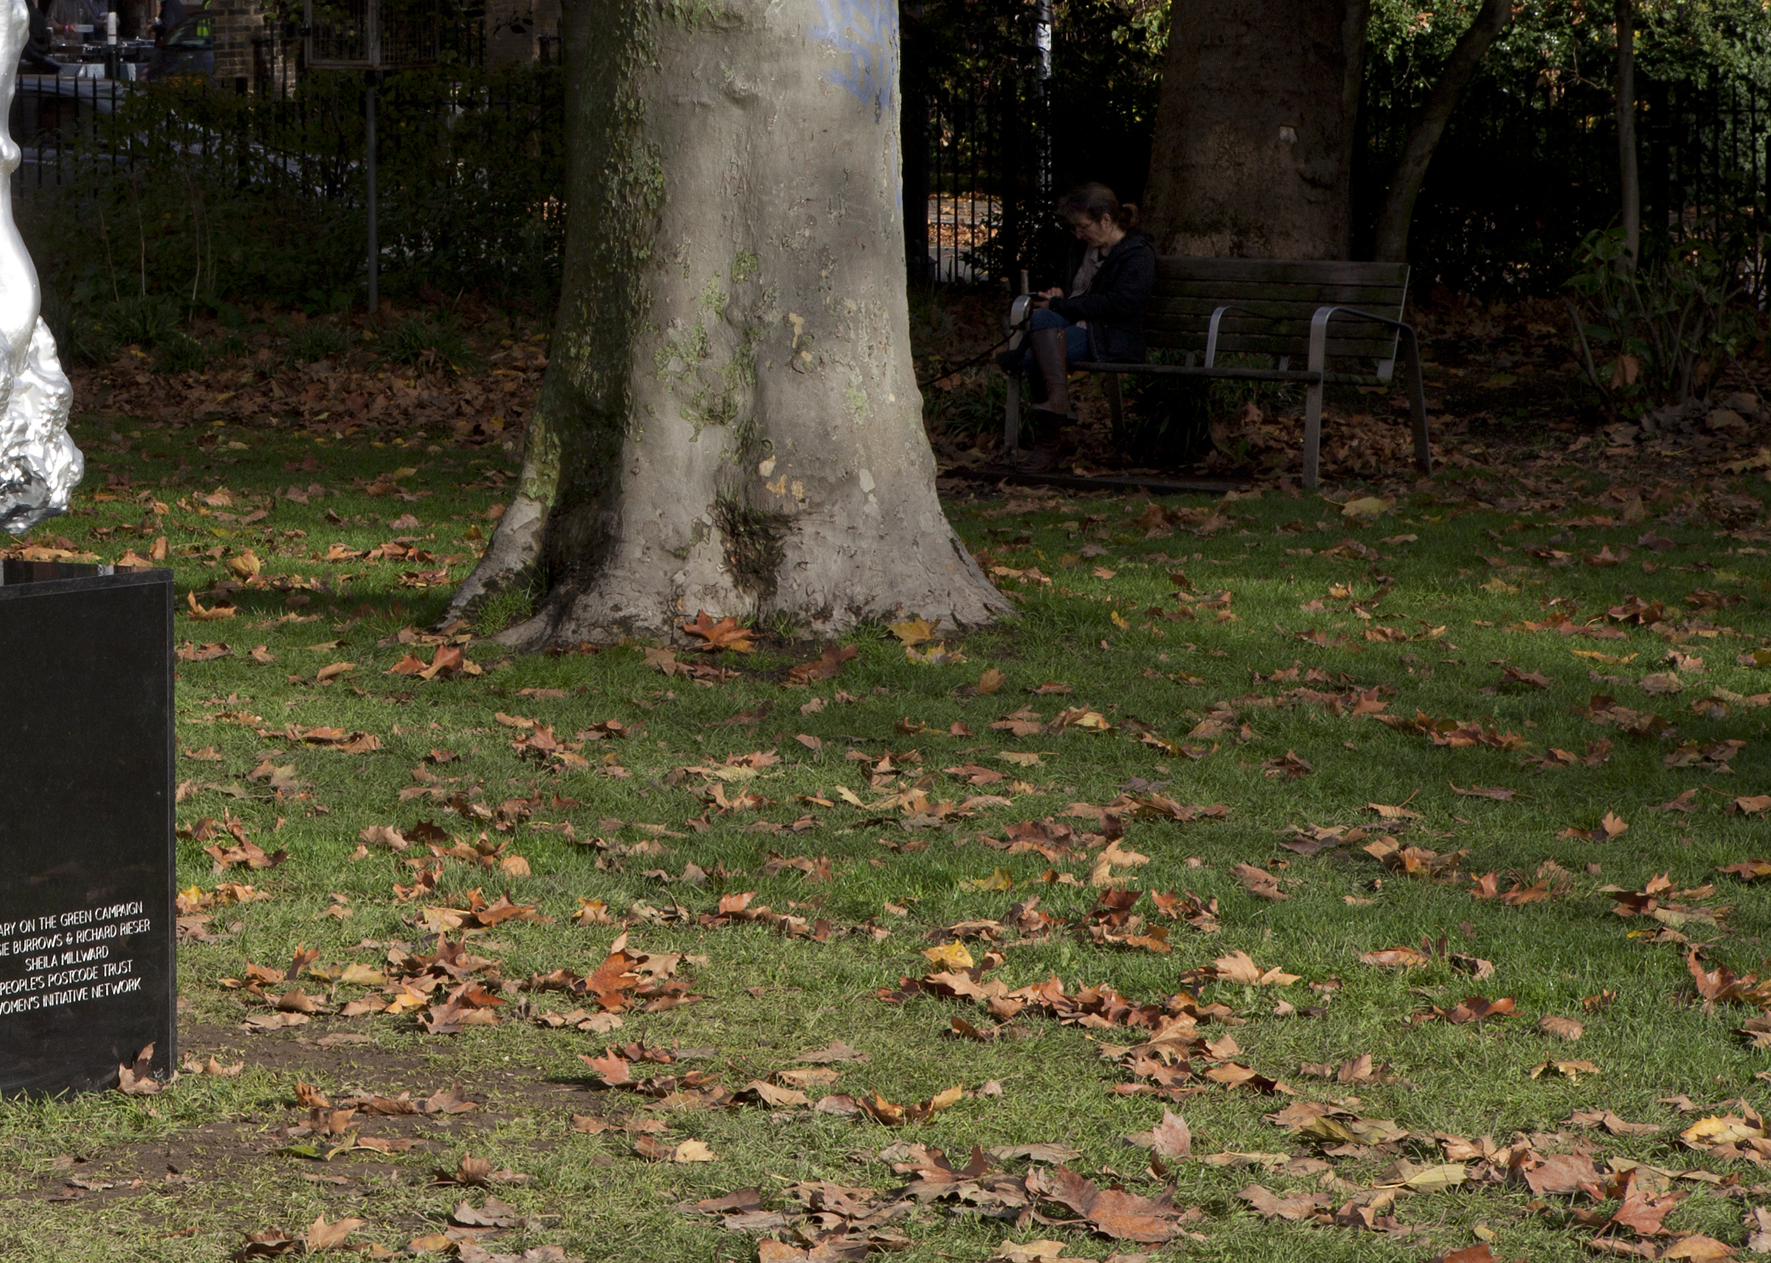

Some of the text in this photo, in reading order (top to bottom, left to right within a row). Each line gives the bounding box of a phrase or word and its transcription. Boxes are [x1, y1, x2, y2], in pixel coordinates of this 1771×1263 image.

[19, 918, 36, 934] ON
[38, 914, 57, 931] THE
[60, 909, 92, 927] GREEN
[94, 900, 143, 921] CAMPAIGN
[12, 933, 63, 955] BURROWS
[66, 931, 73, 945] &
[76, 924, 117, 944] RICHARD
[119, 918, 151, 936] RIESER
[25, 944, 109, 972] SHEILA MILLWARD
[0, 958, 133, 996] PEOPLE'S POSTCODE TRUST
[42, 986, 88, 1008] INITIATIVE
[91, 977, 142, 999] NETWORK
